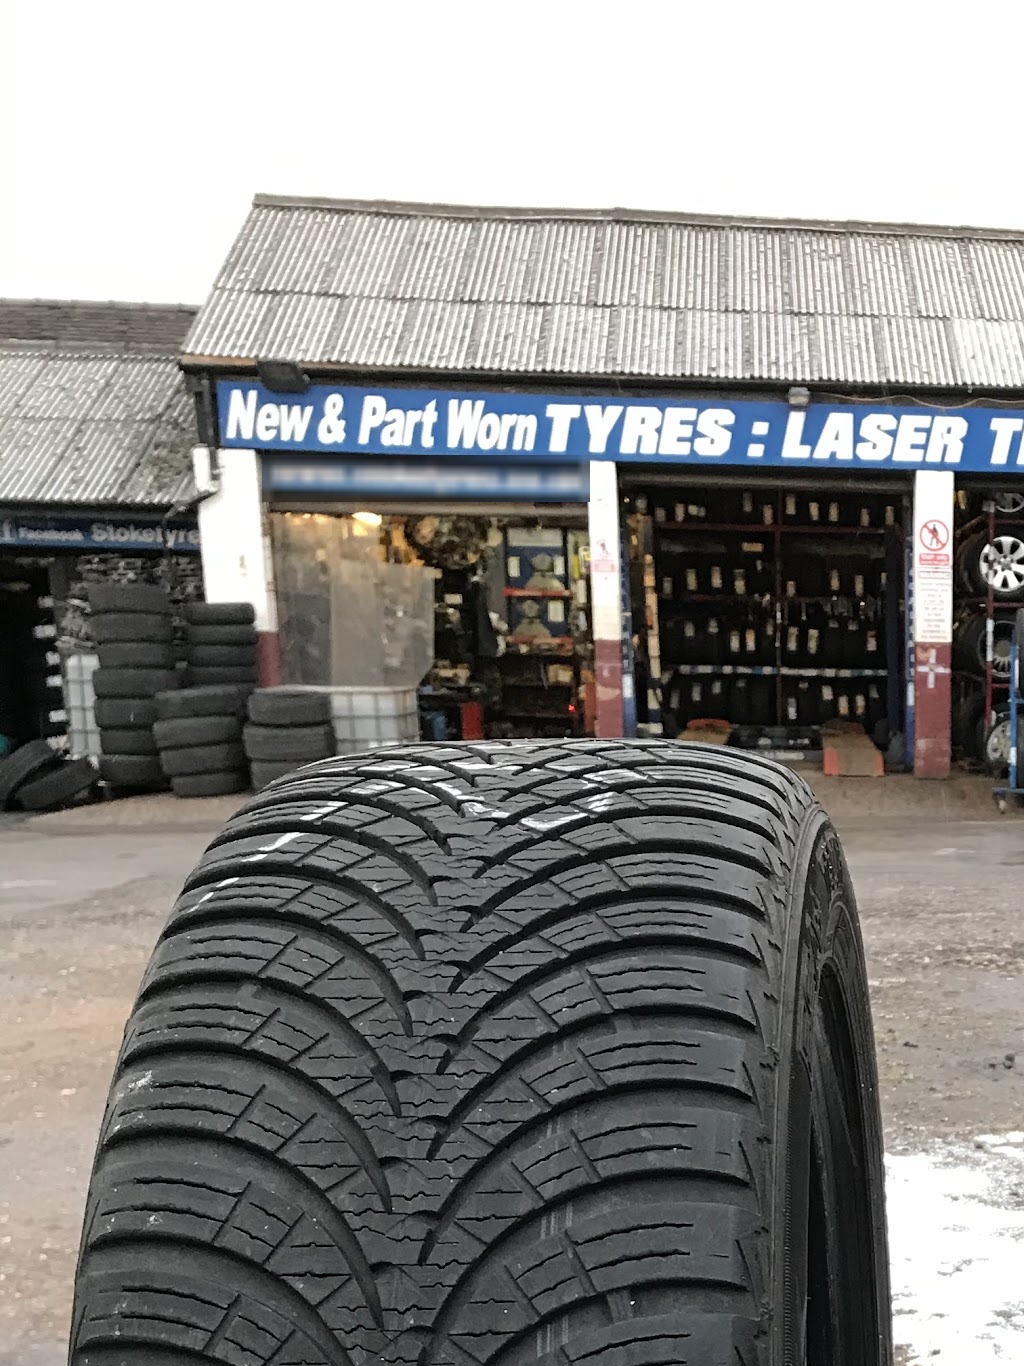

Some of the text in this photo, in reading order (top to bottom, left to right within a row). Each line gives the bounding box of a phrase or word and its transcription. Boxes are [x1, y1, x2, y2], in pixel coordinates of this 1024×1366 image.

[226, 389, 314, 442] New
[317, 393, 346, 444] &
[358, 395, 438, 448] Part
[447, 399, 538, 451] Worn
[545, 403, 736, 456] TYRES
[781, 411, 968, 463] LASER
